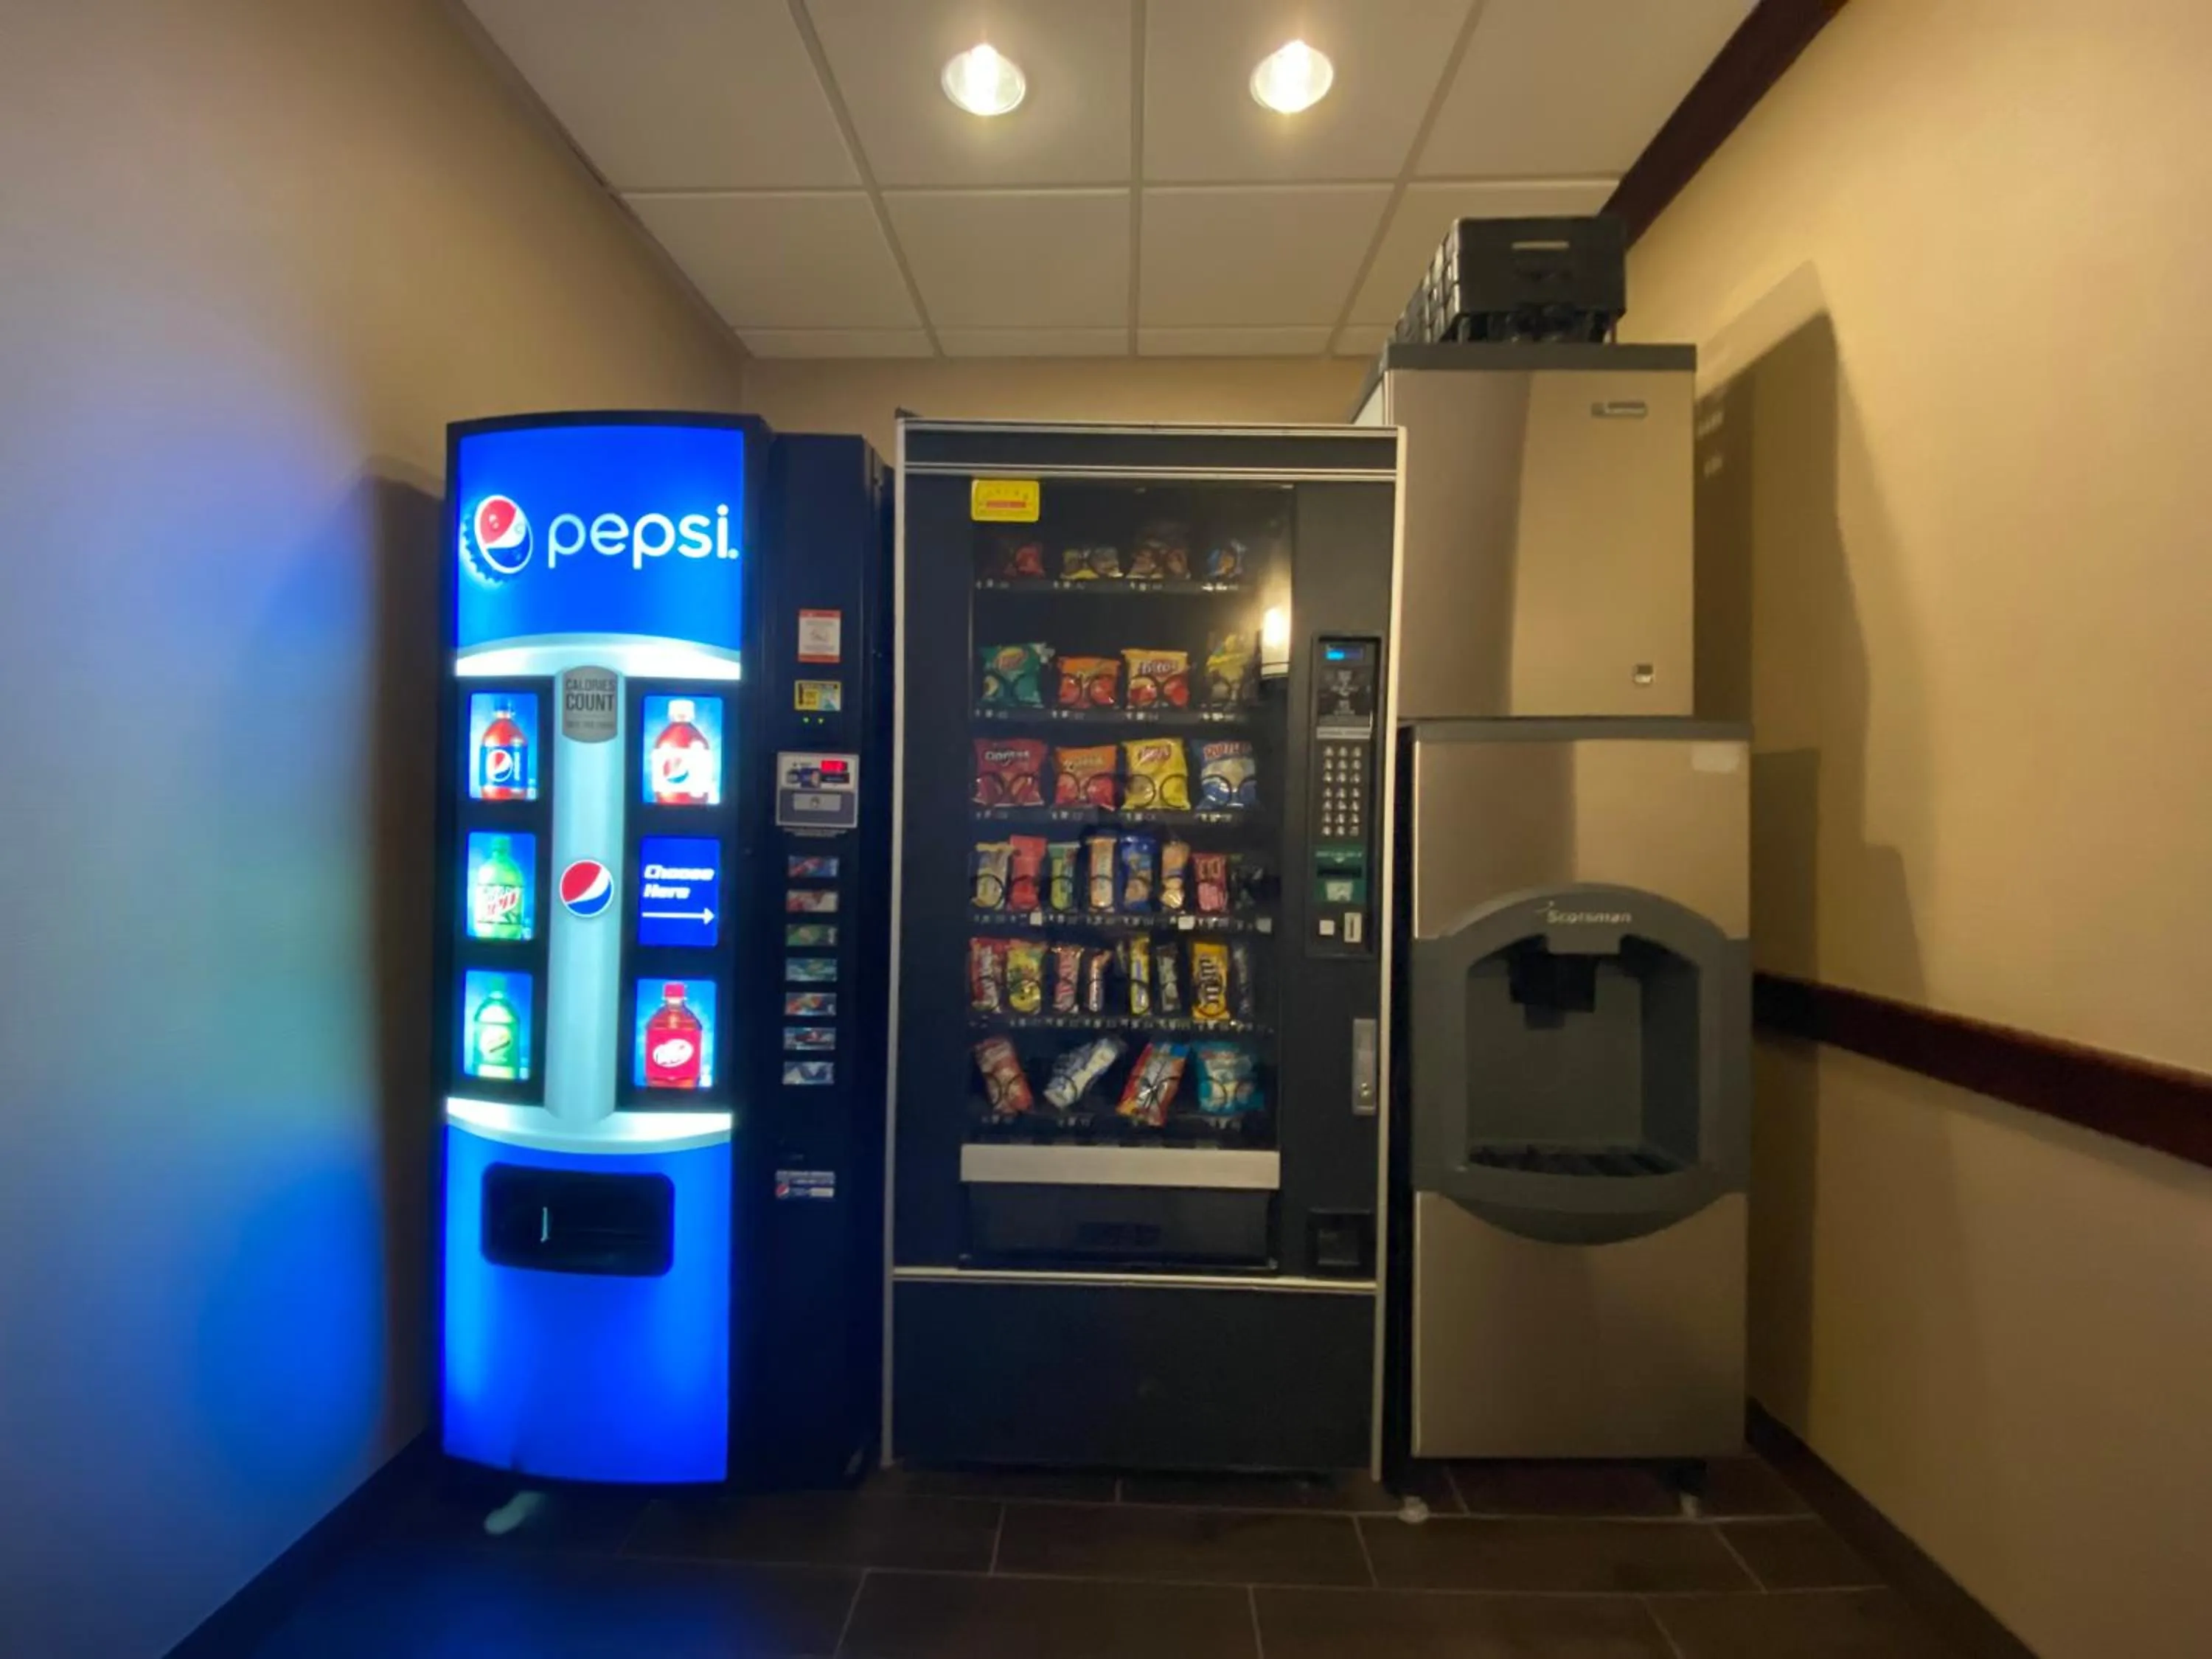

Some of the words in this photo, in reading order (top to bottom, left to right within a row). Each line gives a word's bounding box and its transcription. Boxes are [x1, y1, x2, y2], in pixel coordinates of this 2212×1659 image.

[566, 678, 616, 692] CALORIES
[566, 693, 614, 712] COUNT
[643, 883, 691, 899] Here
